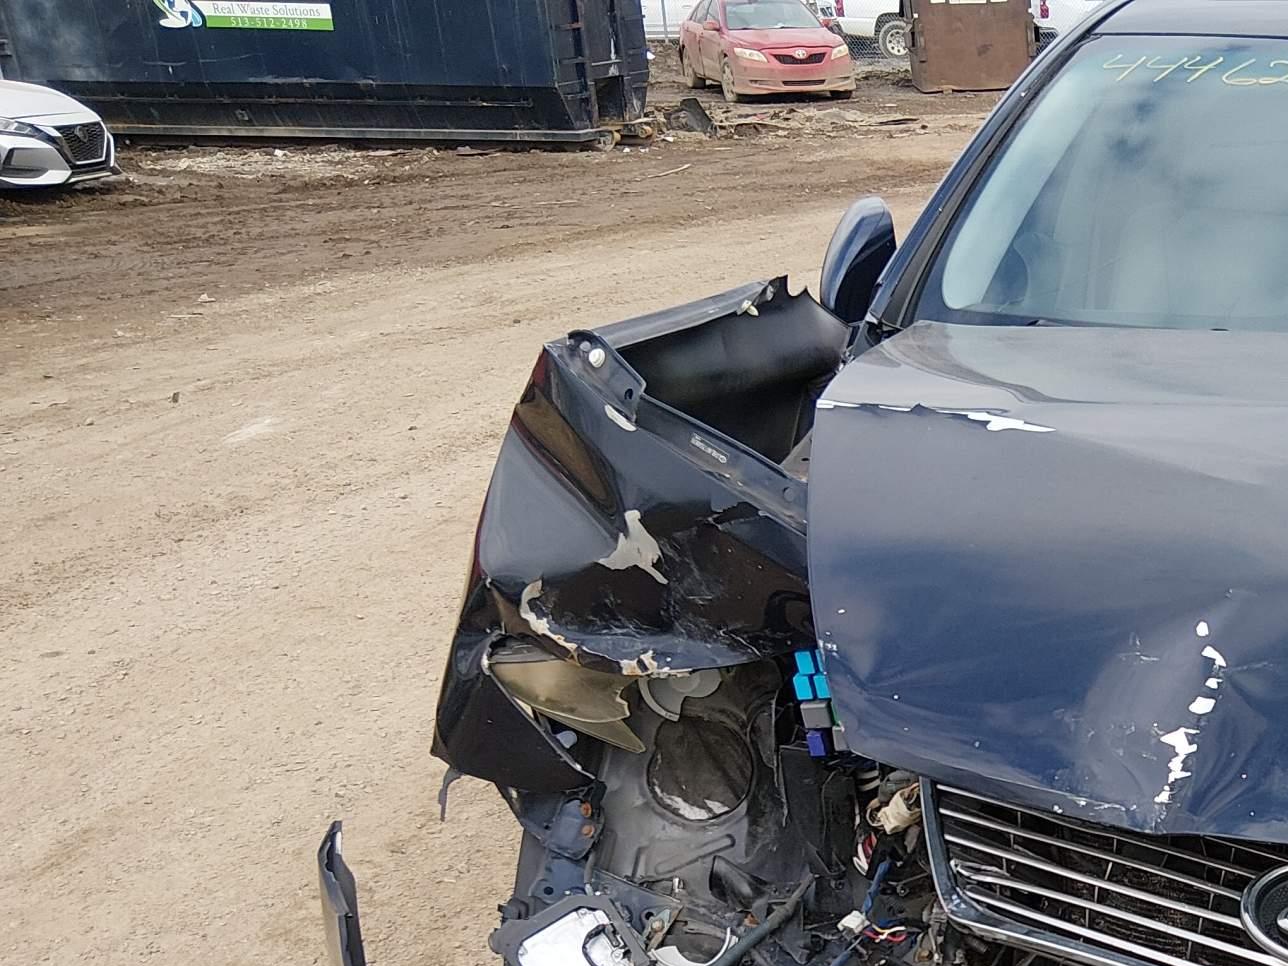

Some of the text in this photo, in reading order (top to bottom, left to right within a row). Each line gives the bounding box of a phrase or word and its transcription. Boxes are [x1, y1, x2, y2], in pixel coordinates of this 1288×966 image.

[212, 2, 321, 17] Real Waste Solutions
[230, 17, 308, 29] 513-512-2498
